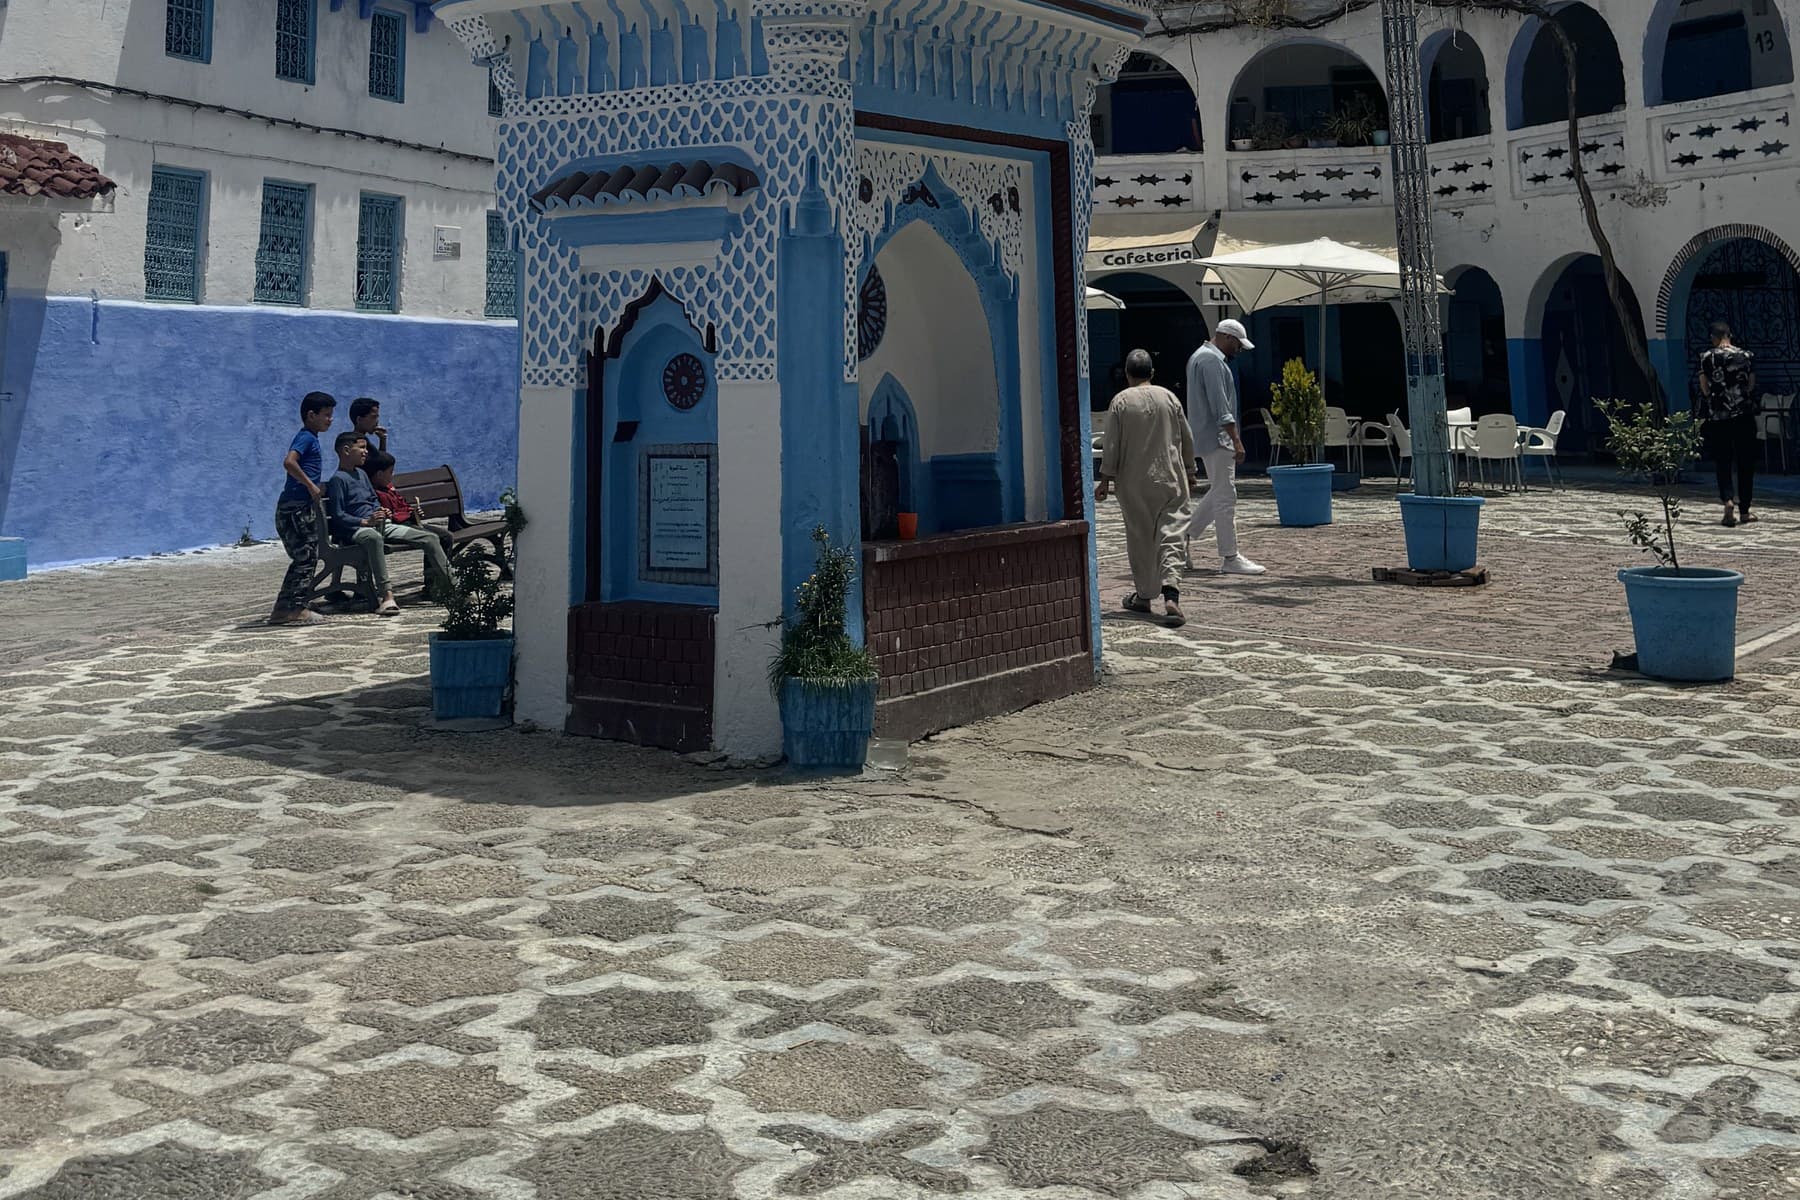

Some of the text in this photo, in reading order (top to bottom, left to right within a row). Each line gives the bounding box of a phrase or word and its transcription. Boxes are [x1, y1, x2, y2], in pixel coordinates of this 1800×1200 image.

[1755, 30, 1774, 53] 13
[1103, 248, 1191, 266] Cafeteria
[1209, 288, 1233, 301] Lh
